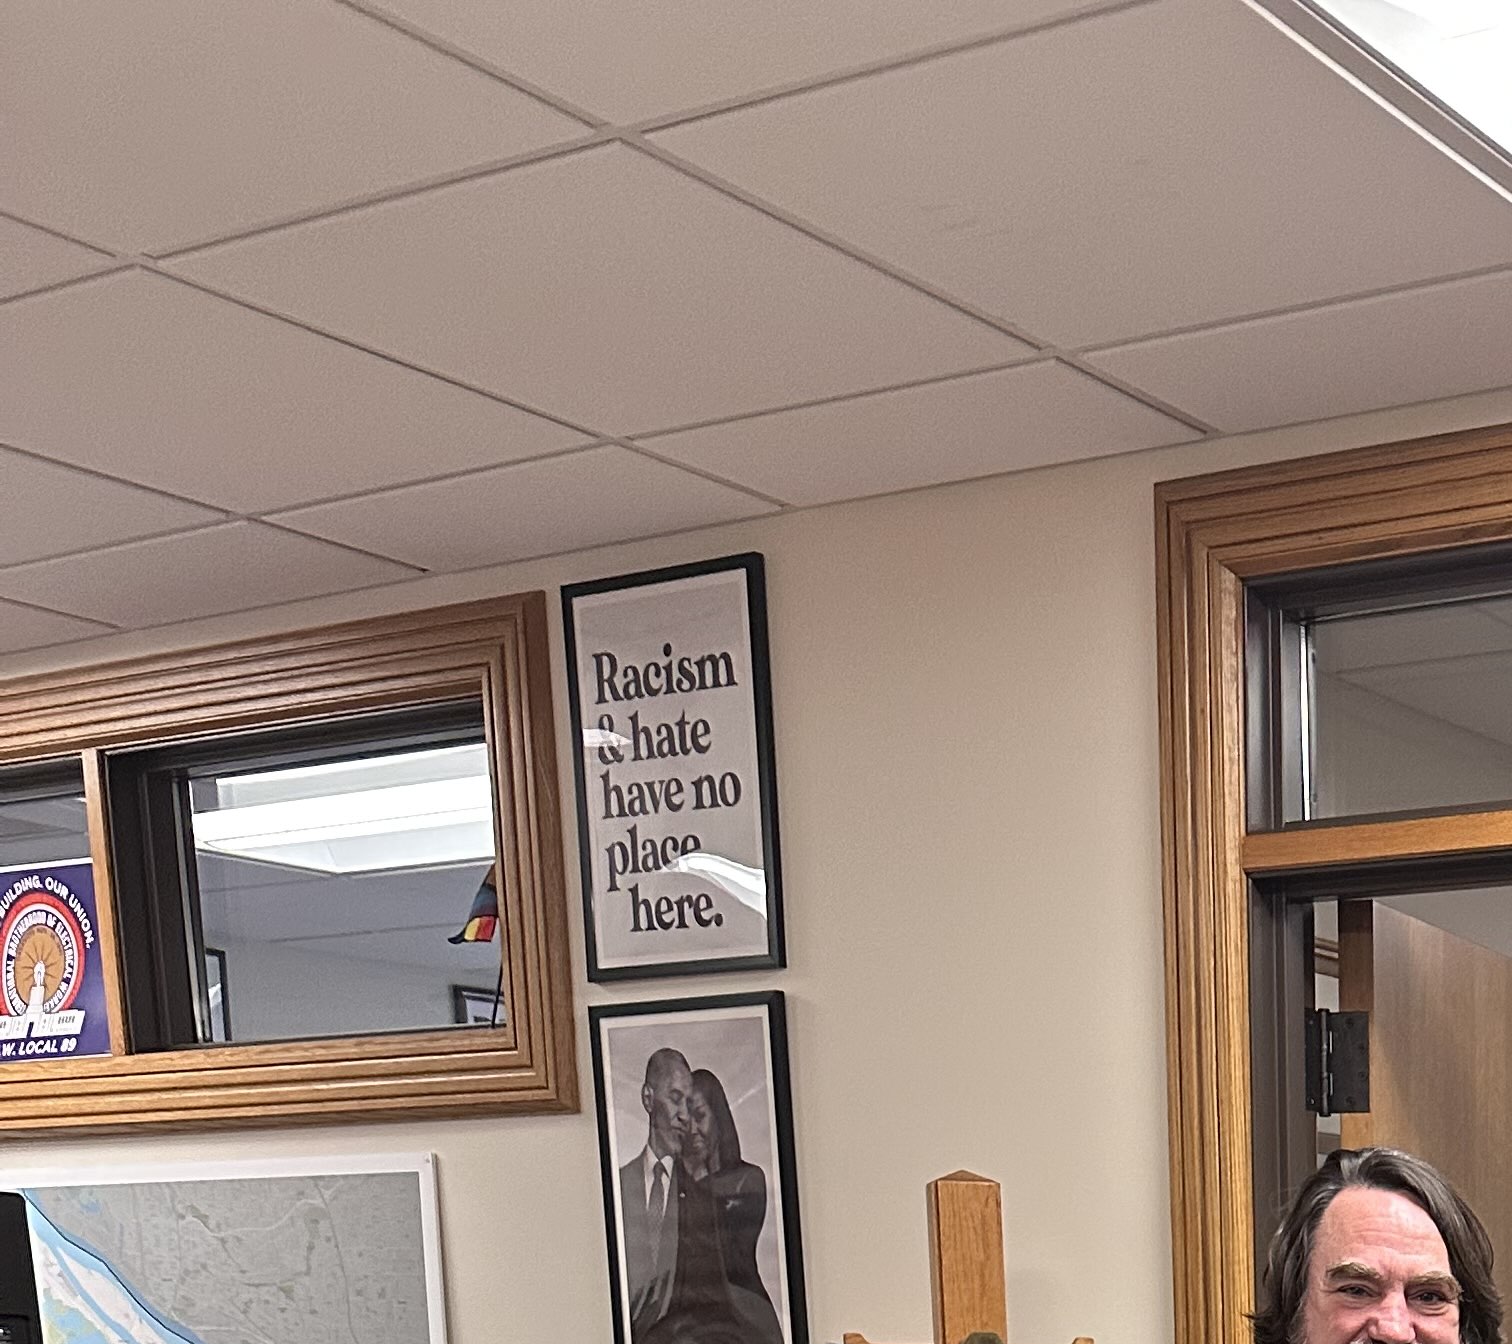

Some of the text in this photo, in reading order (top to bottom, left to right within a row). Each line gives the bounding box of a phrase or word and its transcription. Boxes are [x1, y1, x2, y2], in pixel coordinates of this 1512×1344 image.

[592, 643, 738, 705] Racism
[598, 709, 712, 765] & hate
[599, 769, 742, 820] have no
[605, 823, 702, 892] place
[44, 877, 69, 900] OUR
[68, 893, 95, 949] UNION.
[628, 883, 724, 932] here.
[18, 1039, 58, 1056] LOCAL
